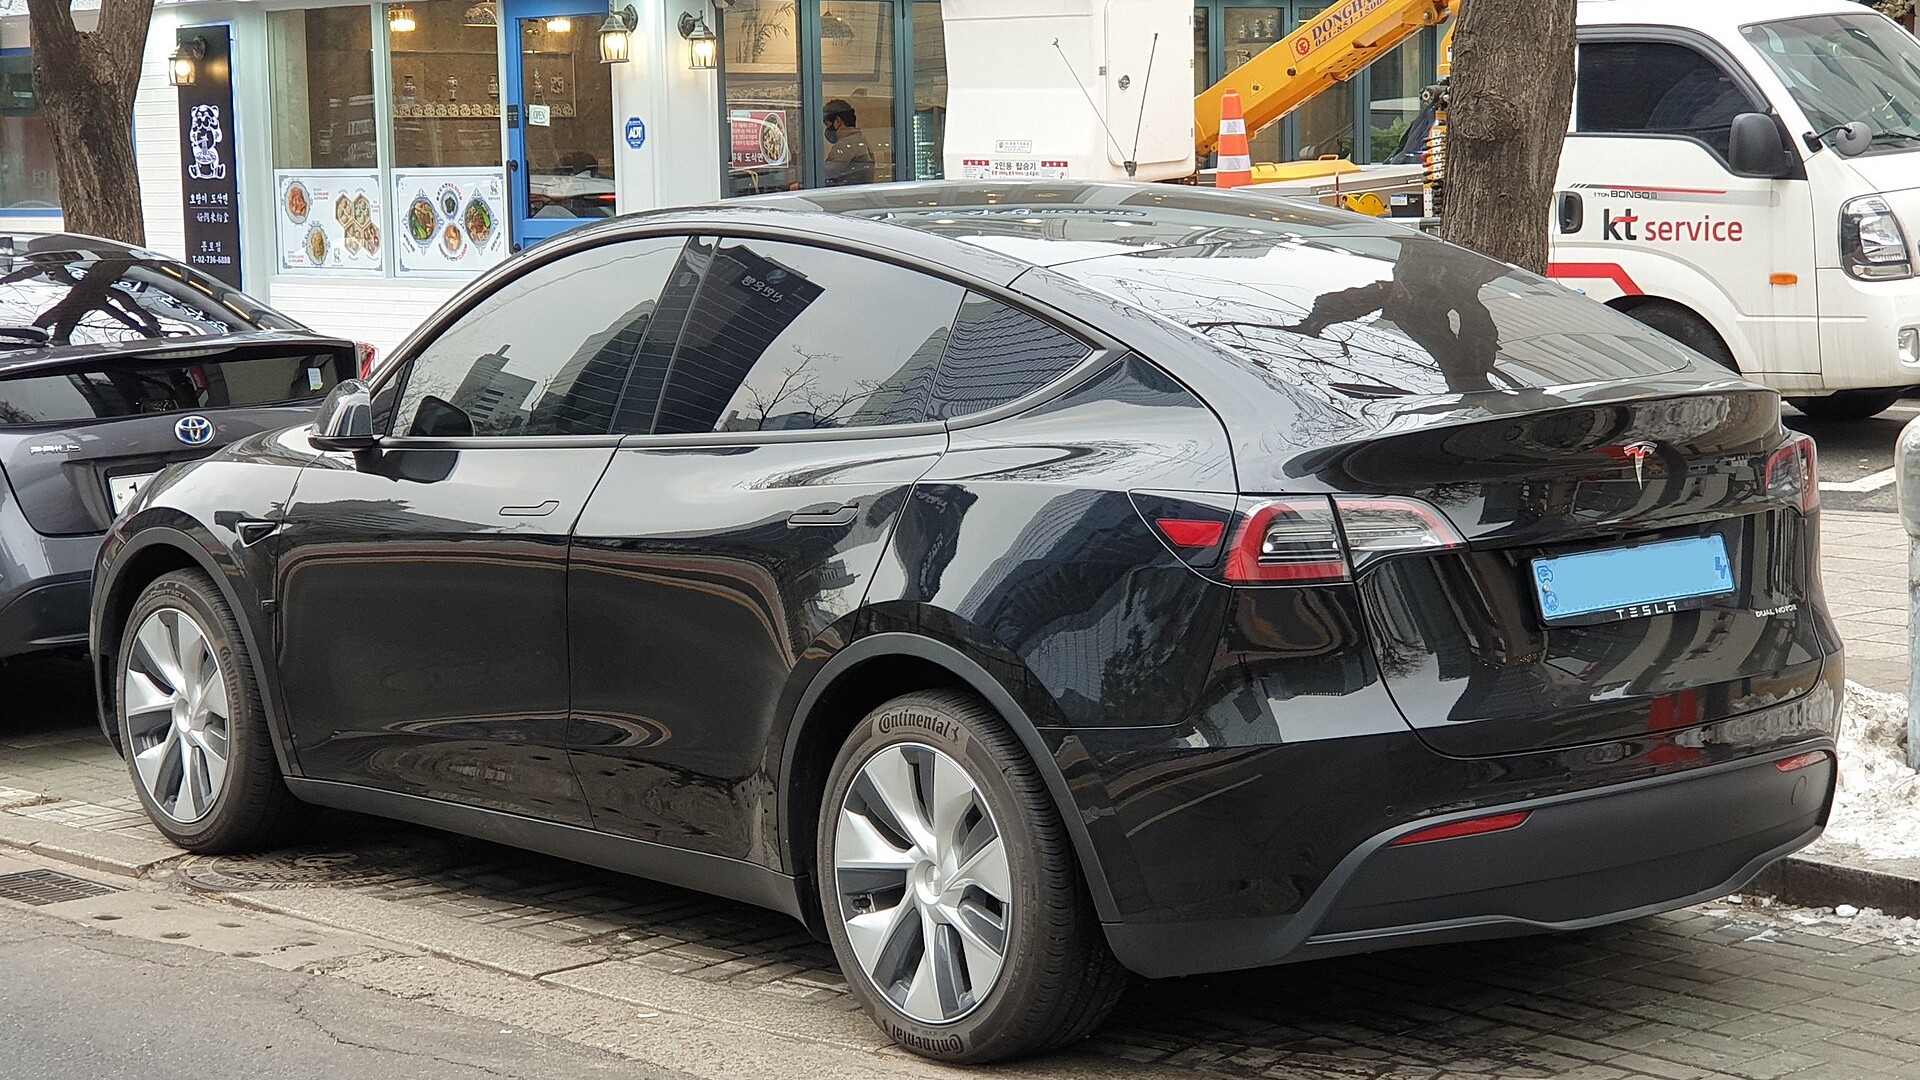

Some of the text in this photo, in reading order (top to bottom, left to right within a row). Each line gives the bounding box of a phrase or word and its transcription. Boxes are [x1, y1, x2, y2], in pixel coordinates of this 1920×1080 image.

[1312, 0, 1373, 40] DONGH
[628, 126, 642, 139] ADT
[1611, 190, 1649, 199] BONGO
[1603, 208, 1743, 242] kt service
[1616, 601, 1677, 619] TESLA
[1755, 608, 1775, 618] DUAL
[220, 646, 244, 730] Continental
[878, 708, 951, 739] Continental
[892, 1023, 965, 1055] Continental
